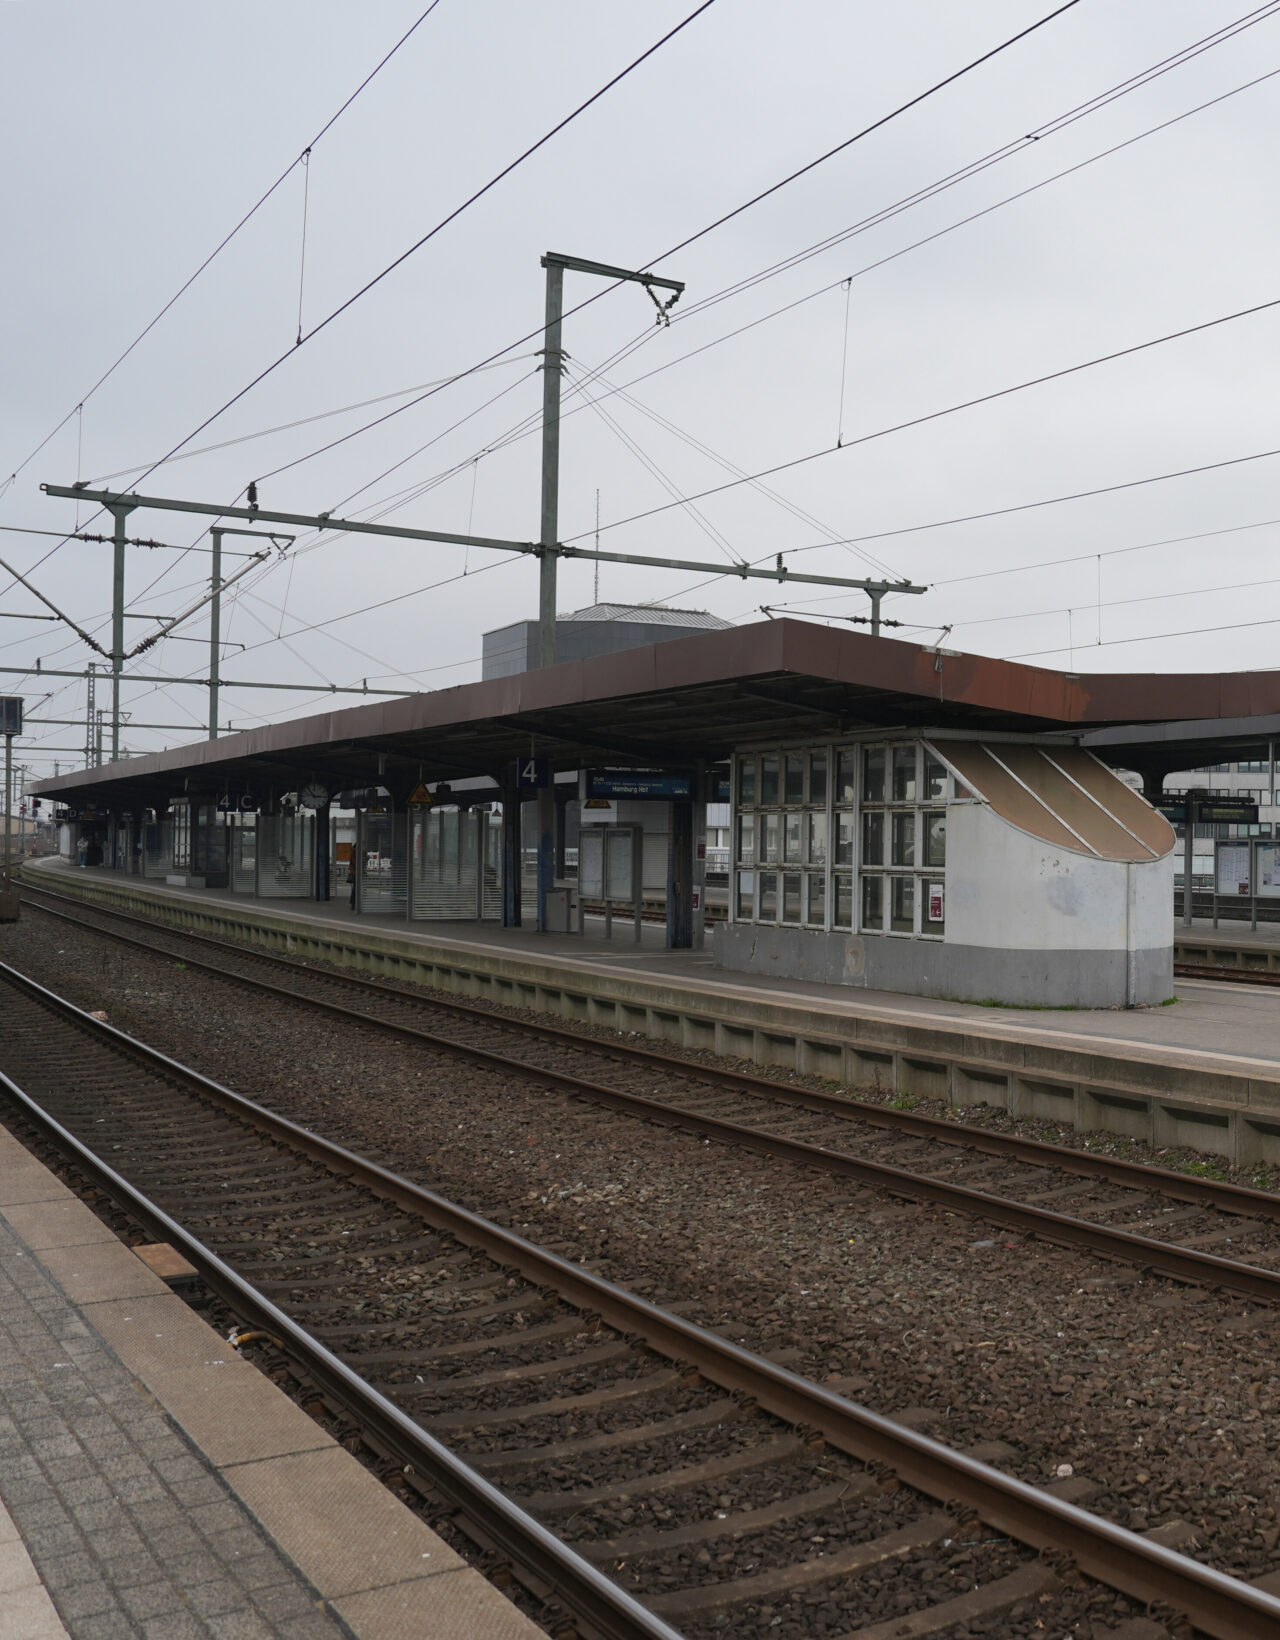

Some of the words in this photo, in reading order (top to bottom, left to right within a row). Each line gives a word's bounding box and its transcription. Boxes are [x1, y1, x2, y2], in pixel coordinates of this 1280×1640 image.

[521, 760, 538, 783] 4
[612, 785, 638, 794] Hamburg
[219, 794, 231, 807] 4
[240, 795, 253, 807] C
